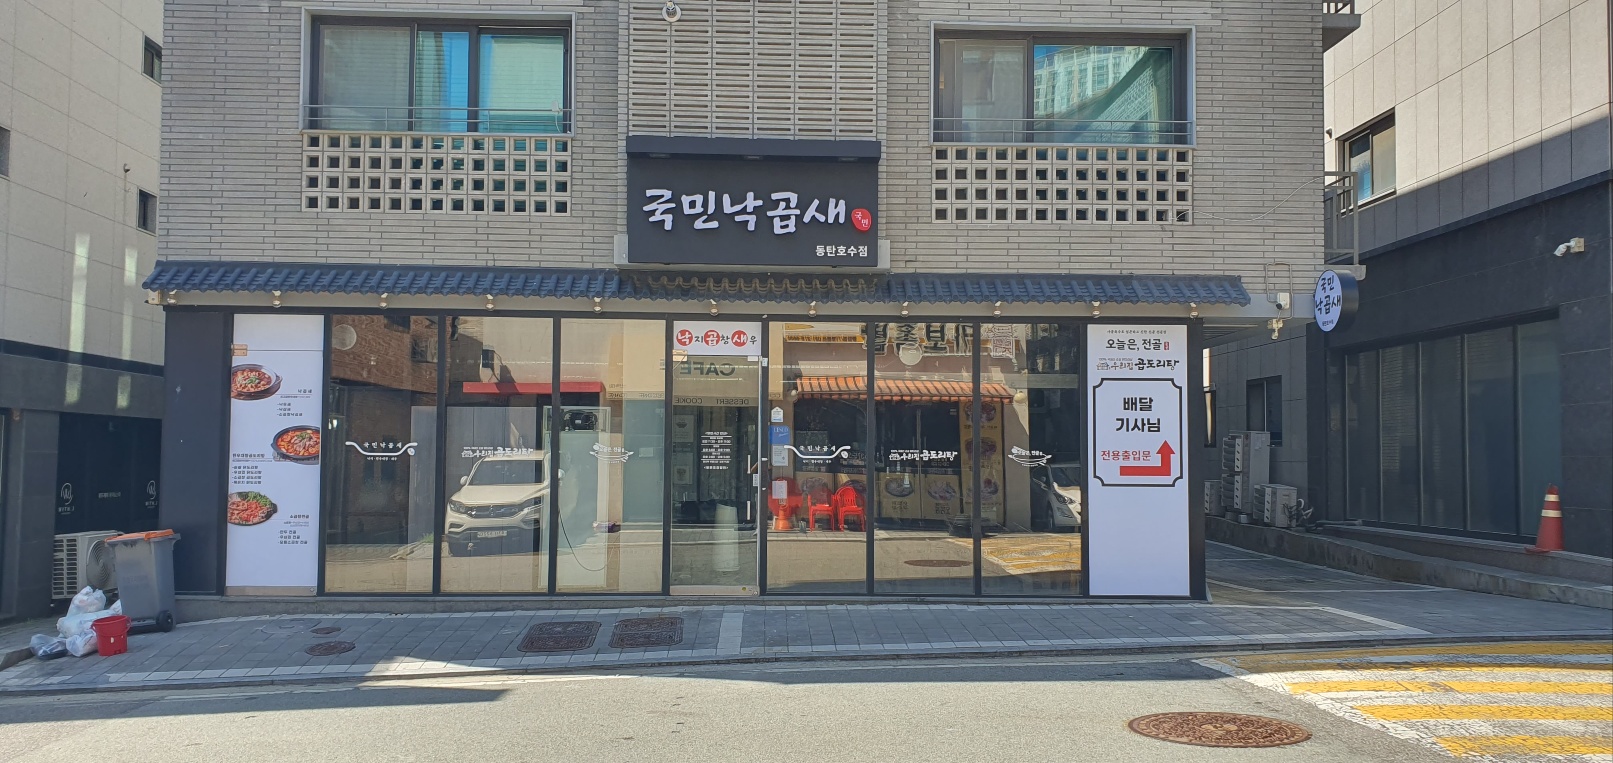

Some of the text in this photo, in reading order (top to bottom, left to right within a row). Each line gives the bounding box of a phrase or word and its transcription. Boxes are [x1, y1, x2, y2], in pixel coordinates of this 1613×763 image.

[642, 188, 847, 235] 국민낙곱새
[854, 212, 868, 228] 국민
[815, 245, 868, 257] 동탄호수점
[1320, 275, 1334, 294] 국민
[1316, 294, 1341, 314] 낙곱새
[1106, 338, 1162, 351] 오늘은, 전골
[1111, 358, 1180, 370] 우리집 곱도리탕
[1123, 397, 1154, 411] 배달
[1116, 418, 1161, 432] 기사님
[920, 450, 958, 461] 곱도리탕
[1101, 450, 1152, 461] 전용출입문
